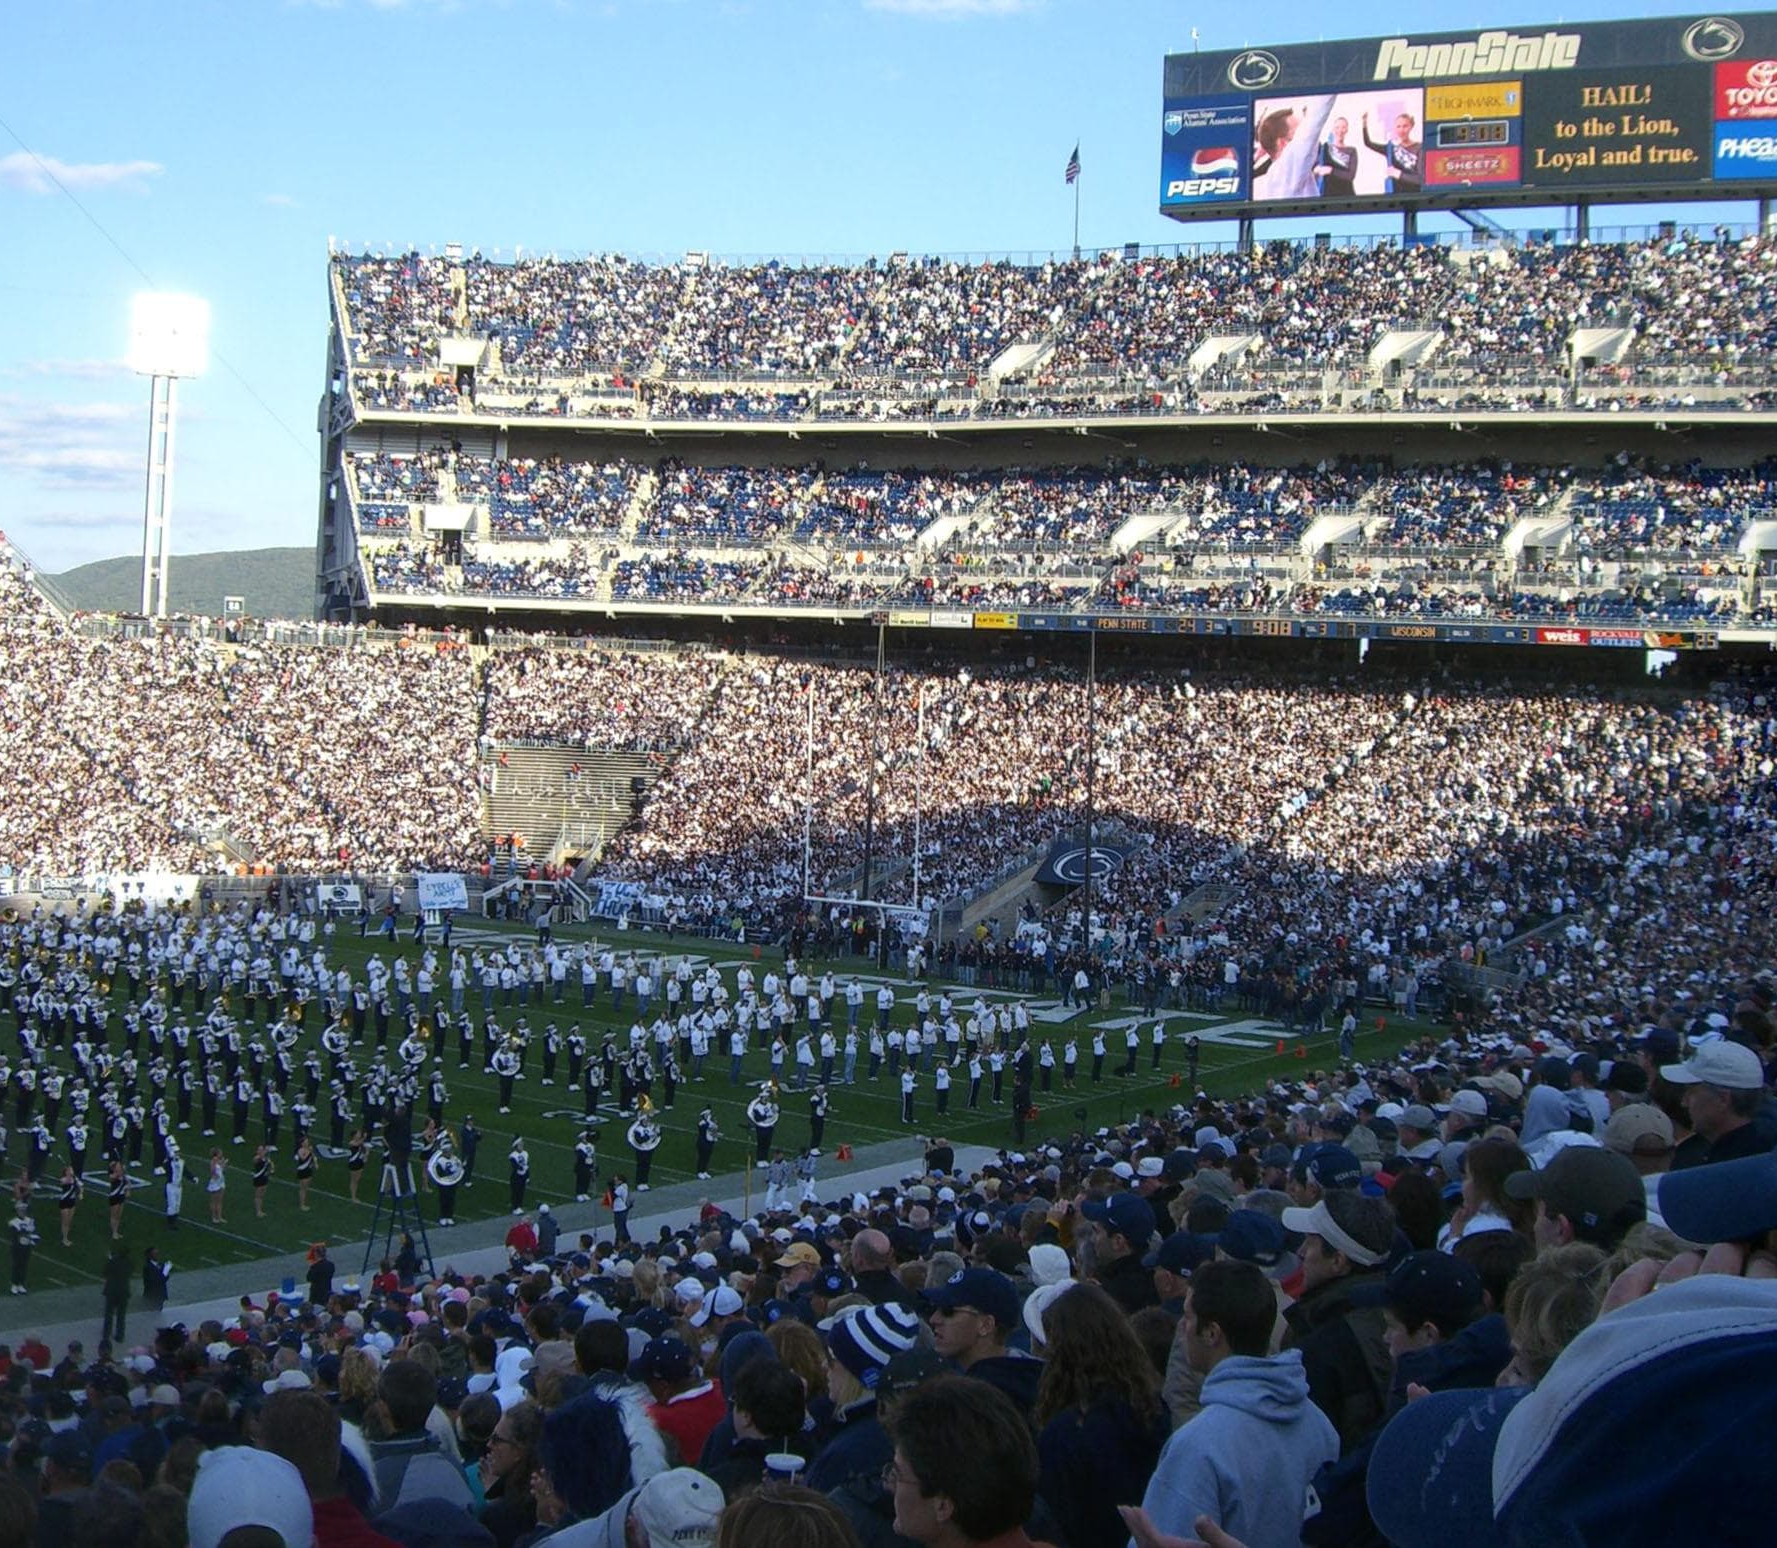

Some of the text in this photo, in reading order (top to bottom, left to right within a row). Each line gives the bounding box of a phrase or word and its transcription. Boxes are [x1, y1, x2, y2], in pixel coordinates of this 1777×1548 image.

[1582, 85, 1652, 107] HAIL!
[1555, 115, 1679, 138] to the Lion,
[1446, 159, 1500, 170] SHEETZ
[1535, 145, 1699, 171] Loyal and true.
[1166, 177, 1240, 197] PEPSI
[1098, 619, 1119, 629] PENN
[1121, 619, 1147, 630] STATE
[1178, 619, 1195, 633] 24
[1205, 620, 1213, 633] 3
[1252, 620, 1292, 635] 9:08
[1319, 623, 1327, 635] 3
[1348, 622, 1356, 637] 7
[1391, 626, 1436, 638] WISCONSIN
[1521, 629, 1530, 641] 3
[1544, 629, 1581, 643] weis
[1590, 638, 1642, 647] OUTLETS
[1696, 632, 1717, 649] 25
